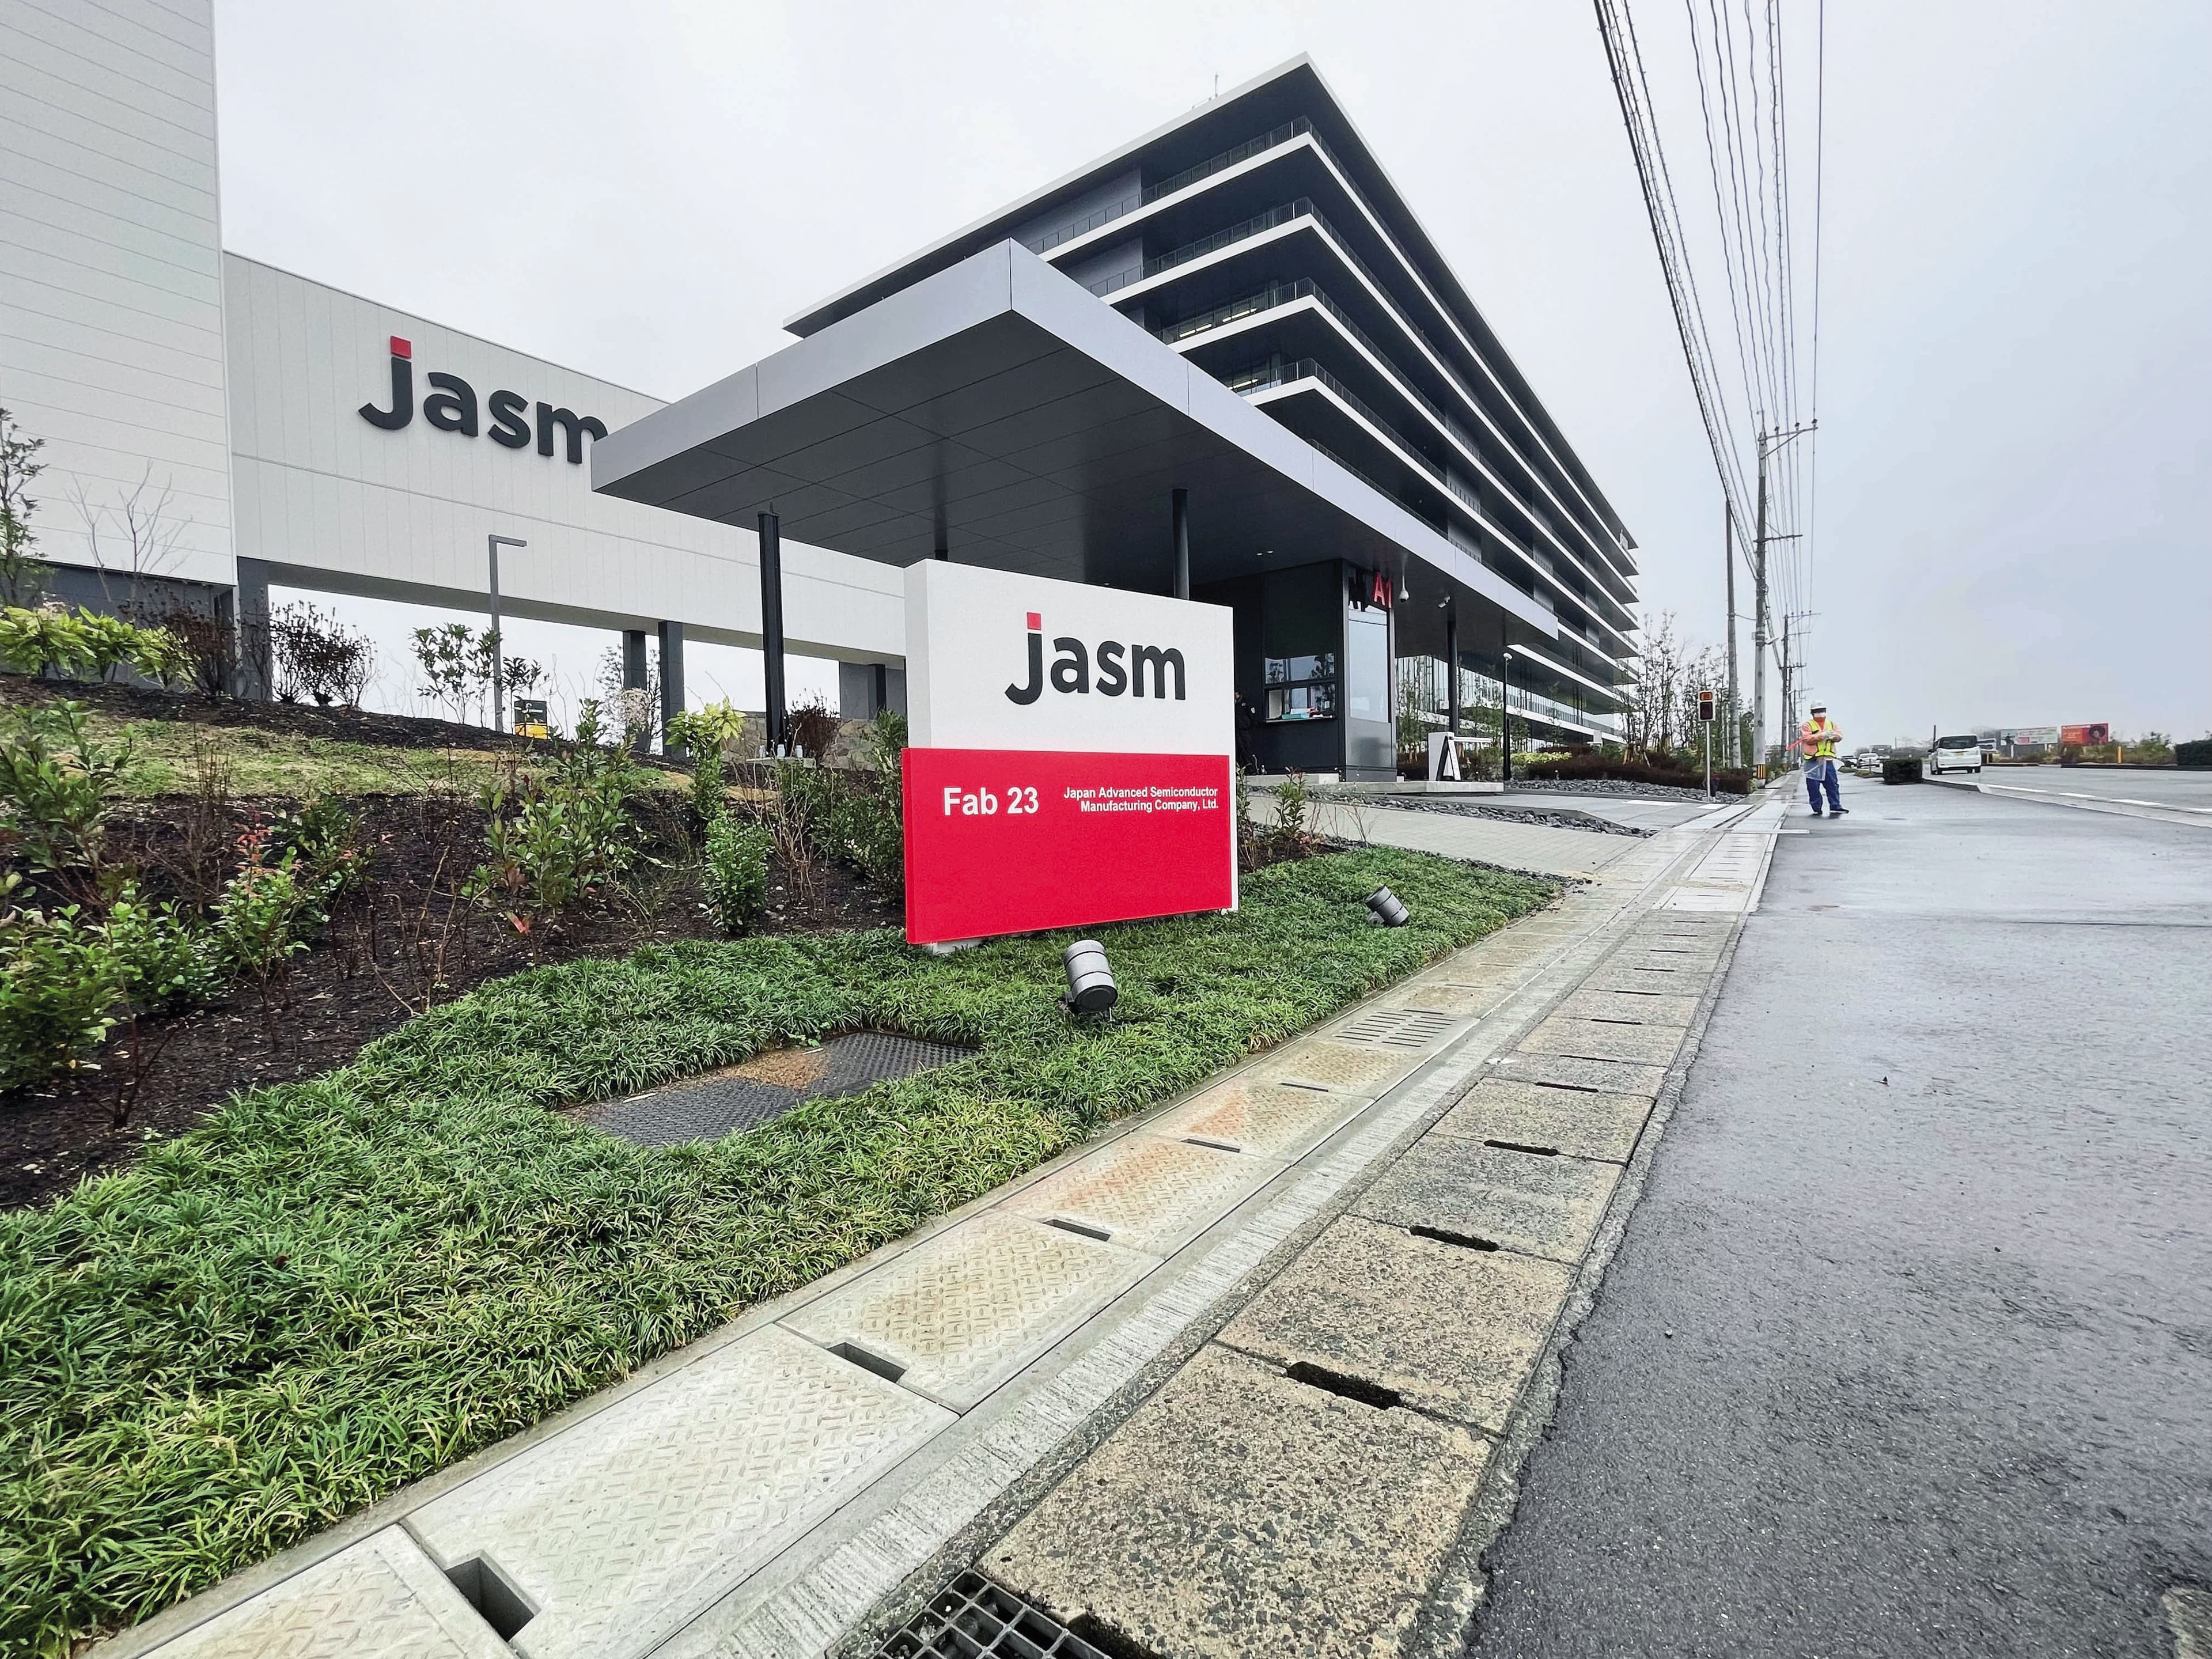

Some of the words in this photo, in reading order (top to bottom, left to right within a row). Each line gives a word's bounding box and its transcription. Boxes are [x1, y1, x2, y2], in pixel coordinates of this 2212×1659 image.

[358, 335, 608, 465] jasm
[1004, 612, 1186, 706] jasm
[944, 787, 998, 816] Fab
[1007, 786, 1039, 814] 23
[1063, 787, 1096, 801] Japan
[1098, 786, 1148, 798] Advanced
[1150, 786, 1218, 798] Semiconductor
[1081, 800, 1153, 813] Manufacturing
[1154, 799, 1200, 812] Company,
[1202, 798, 1219, 809] Ltd.
